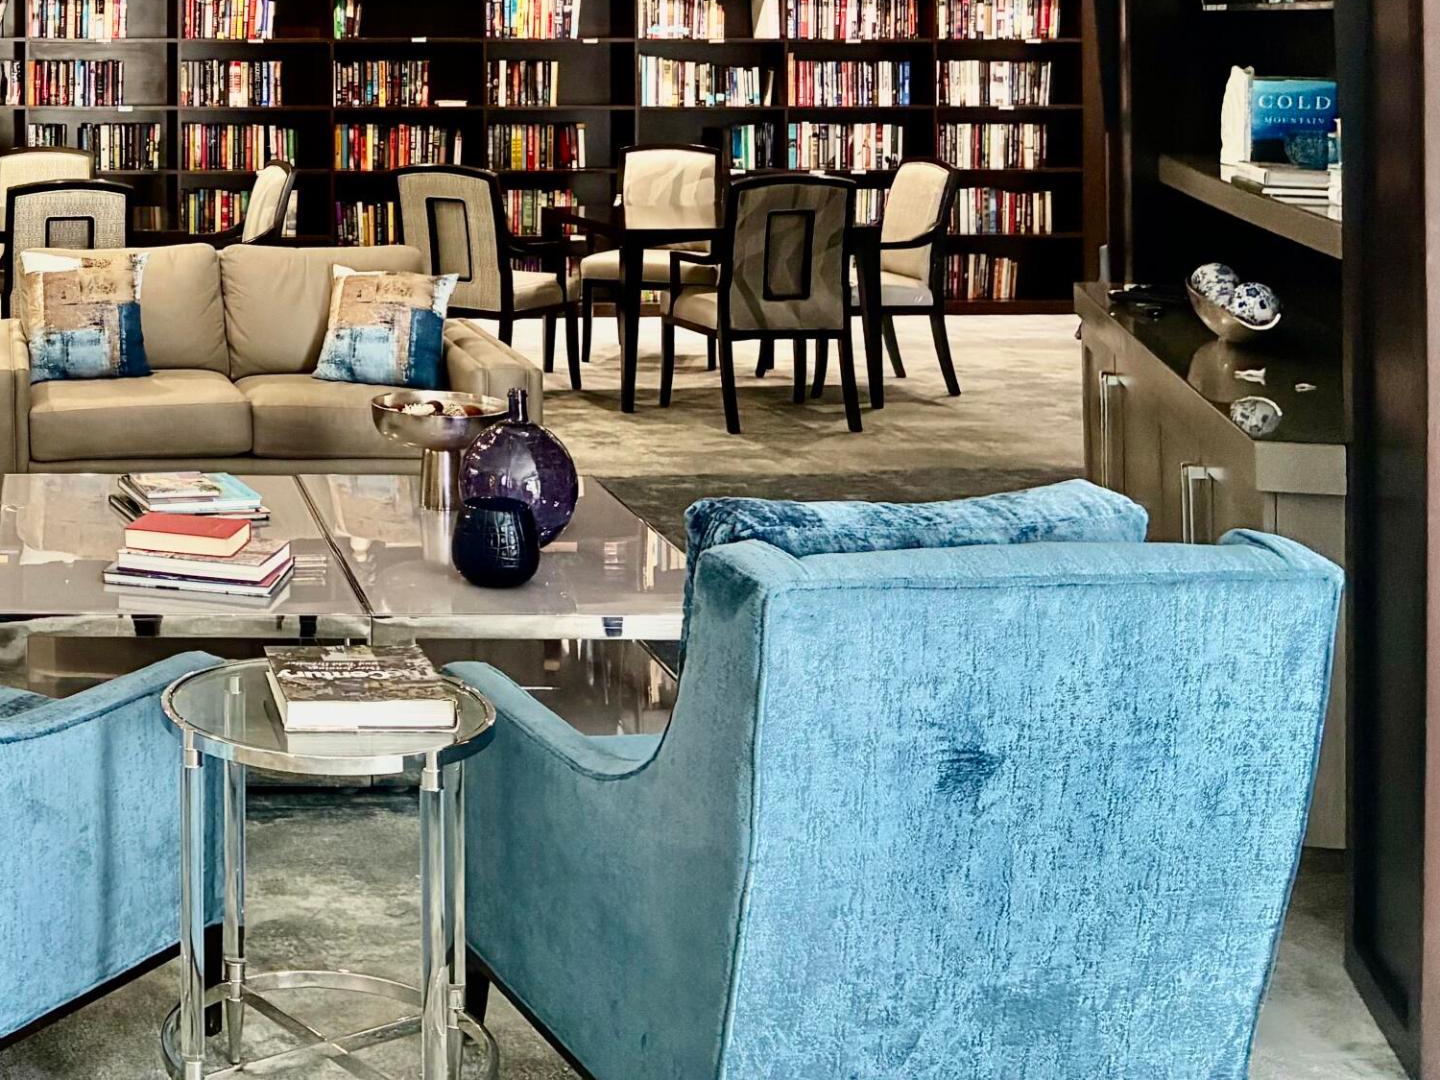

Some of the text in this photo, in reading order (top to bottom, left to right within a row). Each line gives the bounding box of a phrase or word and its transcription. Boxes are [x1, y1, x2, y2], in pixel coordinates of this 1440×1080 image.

[1258, 95, 1332, 110] COLD
[1264, 116, 1325, 125] MOUNTAIN
[276, 669, 388, 680] Century
